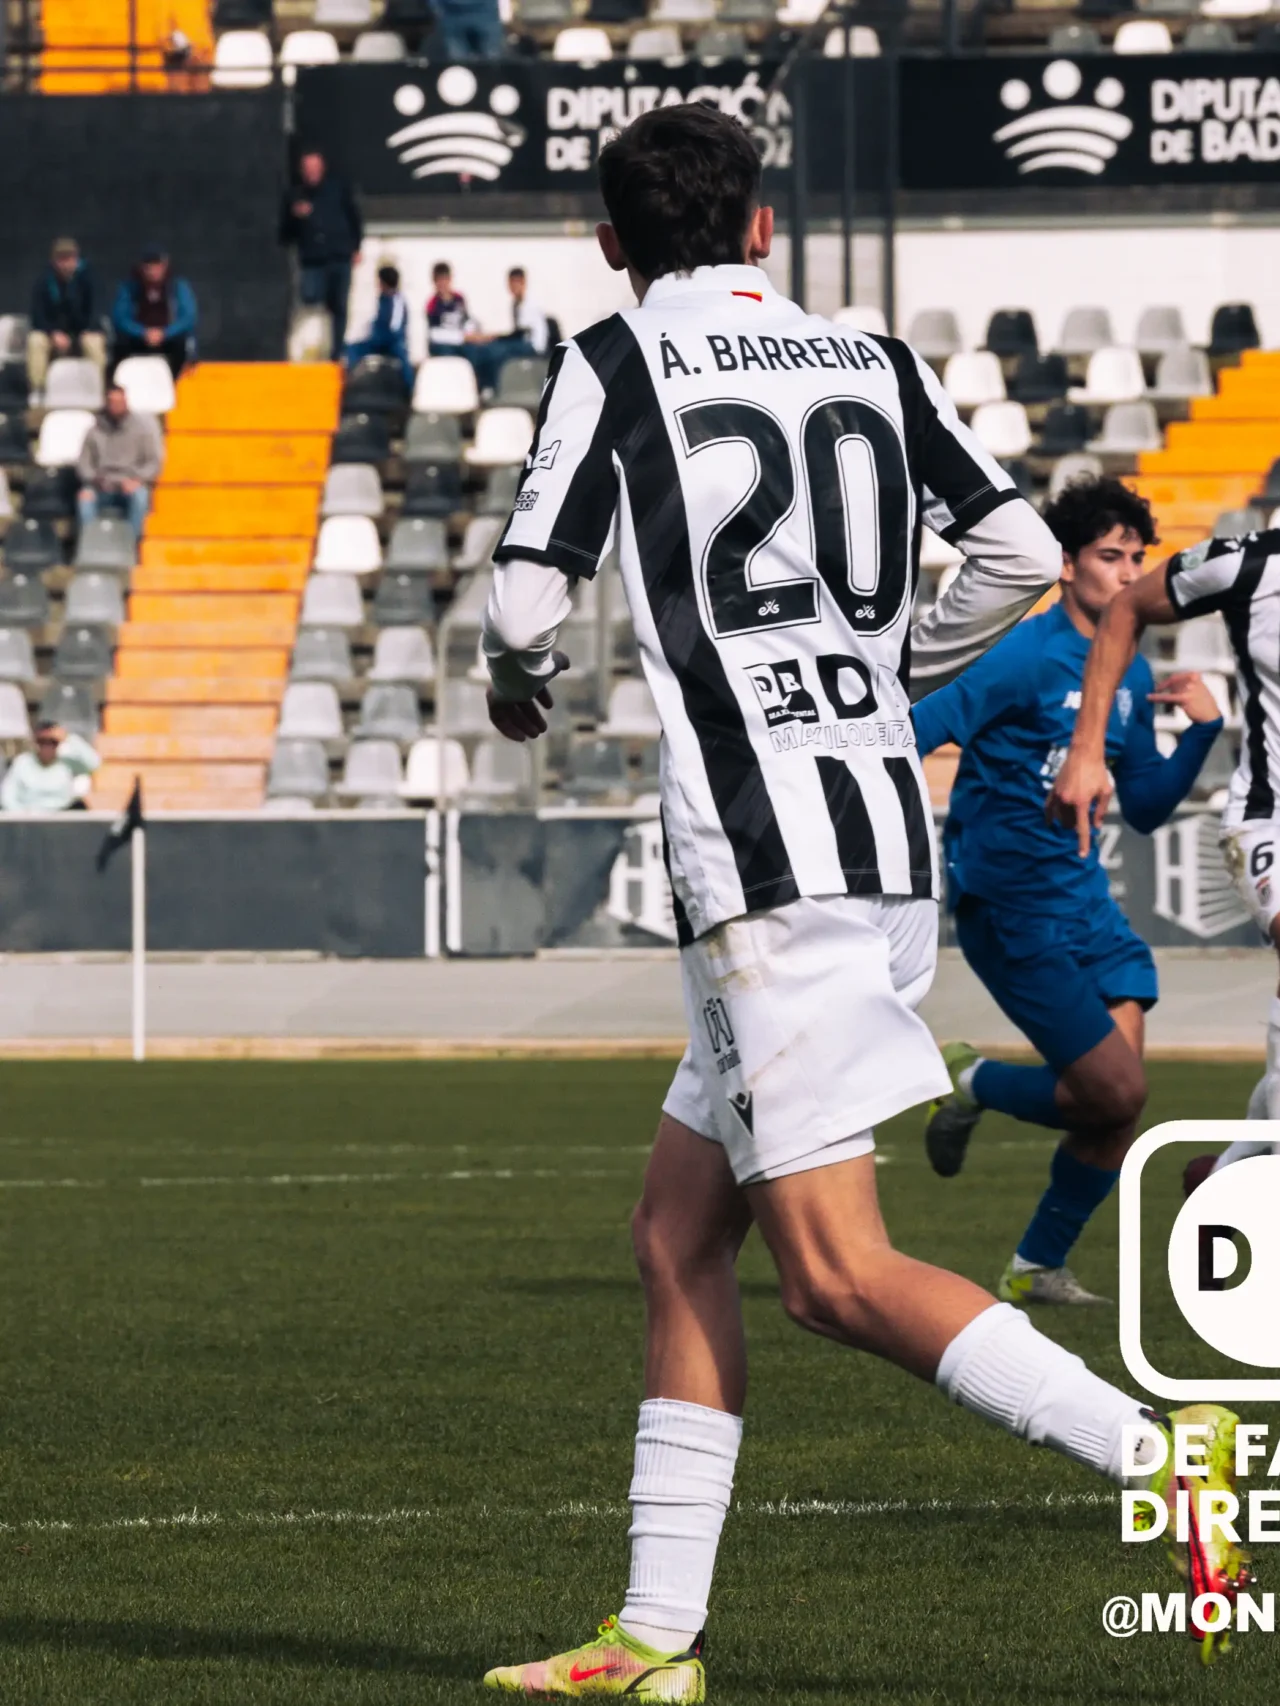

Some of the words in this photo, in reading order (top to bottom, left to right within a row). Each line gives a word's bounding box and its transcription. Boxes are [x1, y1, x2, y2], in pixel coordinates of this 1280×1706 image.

[546, 136, 591, 170] DE
[1151, 129, 1194, 163] DE
[660, 332, 702, 379] Á.
[706, 334, 886, 371] BARRENA
[673, 394, 916, 640] 20
[1251, 841, 1274, 877] 6
